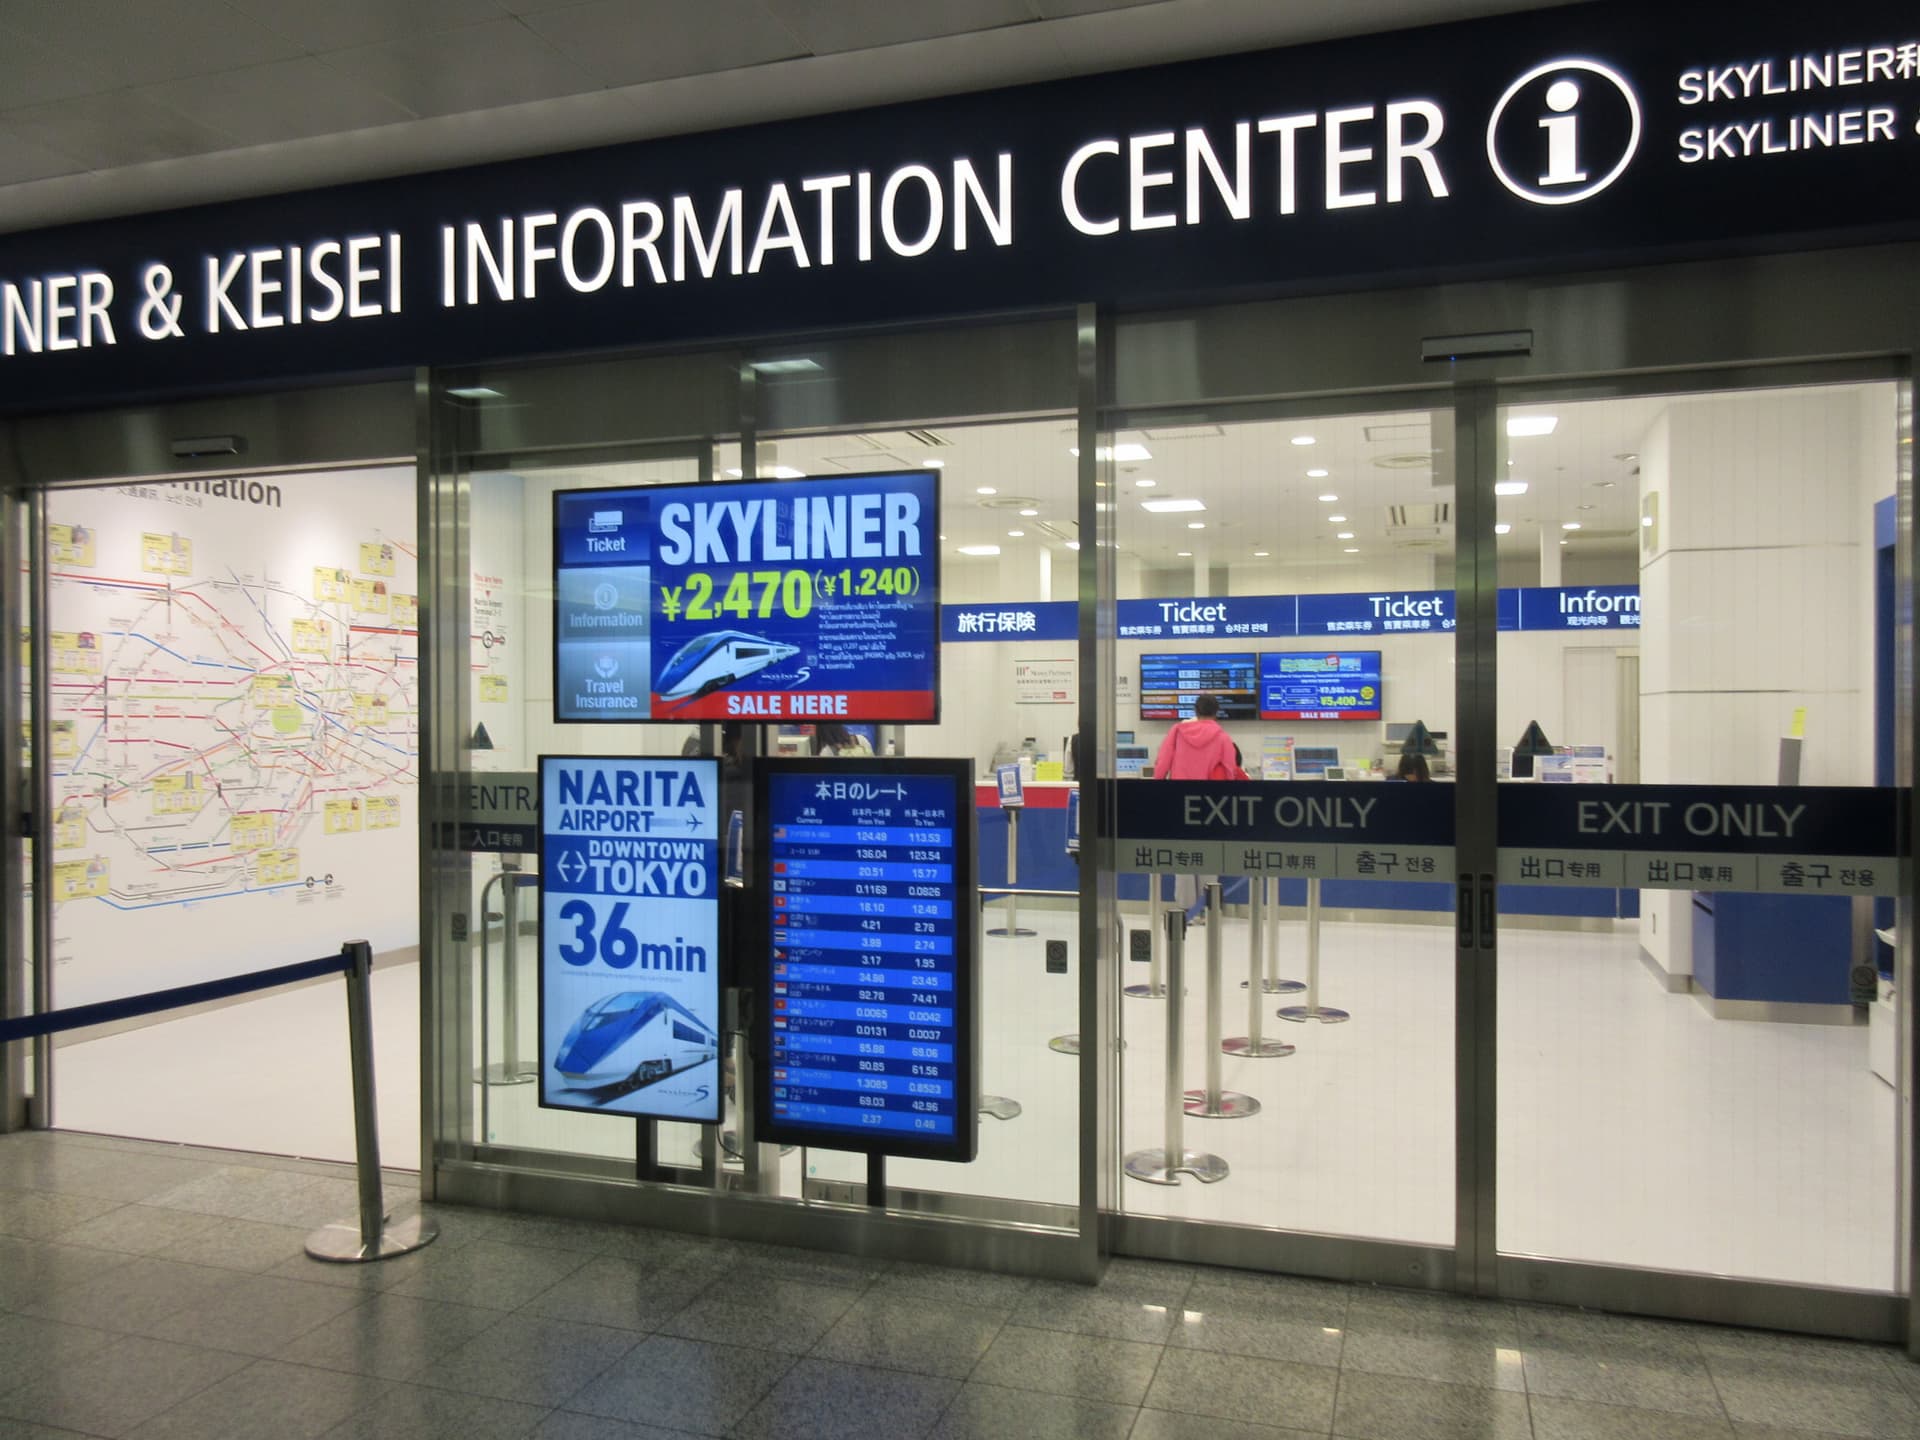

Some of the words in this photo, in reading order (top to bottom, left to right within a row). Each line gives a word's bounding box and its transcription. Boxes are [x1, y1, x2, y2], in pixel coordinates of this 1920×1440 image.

[1677, 108, 1896, 164] SKYLINER
[2, 273, 116, 358] NER
[137, 263, 184, 341] &
[204, 233, 403, 333] KEISEI
[442, 151, 1015, 308] INFORMATION
[1060, 98, 1449, 237] CENTER
[659, 492, 922, 567] SKYLINER
[586, 536, 626, 553] Ticket
[661, 568, 813, 622] ¥2,470
[1368, 594, 1444, 618] Ticket
[570, 612, 643, 628] Information
[957, 611, 1037, 633] 旅行保険
[1158, 600, 1228, 623] Ticket
[585, 678, 625, 694] Travel
[575, 693, 638, 710] Insurance
[727, 694, 785, 716] SALE
[791, 693, 848, 715] HERE
[558, 768, 705, 809] NARITA
[815, 780, 908, 801] 本日のレート
[559, 809, 655, 834] AIRPORT
[1184, 795, 1263, 827] EXIT
[1274, 796, 1378, 829] ONLY
[1577, 800, 1671, 836] EXIT
[1683, 801, 1807, 838] ONLY
[908, 833, 941, 844] 113.53
[588, 839, 705, 861] DOWNTOWN
[856, 849, 888, 859] 136.04
[908, 850, 941, 861] 123.54
[1135, 845, 1204, 869] 出口专用
[858, 866, 884, 877] 20.51
[911, 868, 937, 879] 15.77
[1355, 850, 1399, 875] 출구
[1404, 855, 1437, 874] 전용
[1519, 855, 1601, 880] 出口专用
[588, 858, 708, 897] TOKYO
[1779, 861, 1833, 888] 출구
[1839, 869, 1876, 887] 전용
[861, 919, 881, 930] 4.21
[914, 940, 936, 951] 2.74
[861, 955, 882, 966] 3.17
[911, 975, 938, 986] 23.45
[911, 993, 937, 1004] 74.41
[856, 1025, 887, 1037] 0.0131
[908, 1029, 941, 1041] 0.0037
